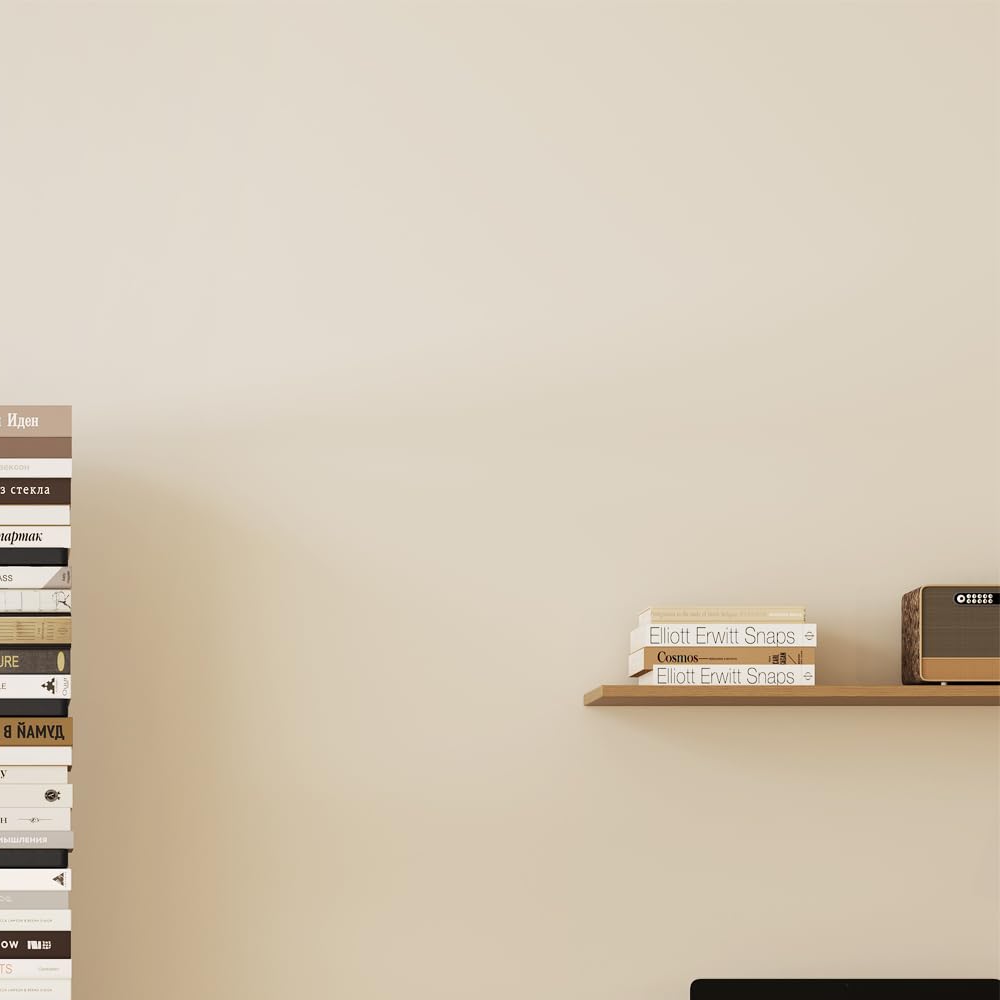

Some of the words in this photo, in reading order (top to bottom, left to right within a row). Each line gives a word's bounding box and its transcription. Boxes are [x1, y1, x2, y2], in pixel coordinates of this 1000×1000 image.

[7, 413, 39, 428] Иден
[10, 486, 50, 495] стекла
[649, 626, 689, 644] Elliott
[696, 626, 739, 644] Erwitt
[745, 626, 796, 647] Snaps
[657, 651, 699, 663] Cosmos
[657, 667, 695, 684] Elliott
[701, 667, 741, 684] Erwitt
[747, 667, 795, 685] Snaps
